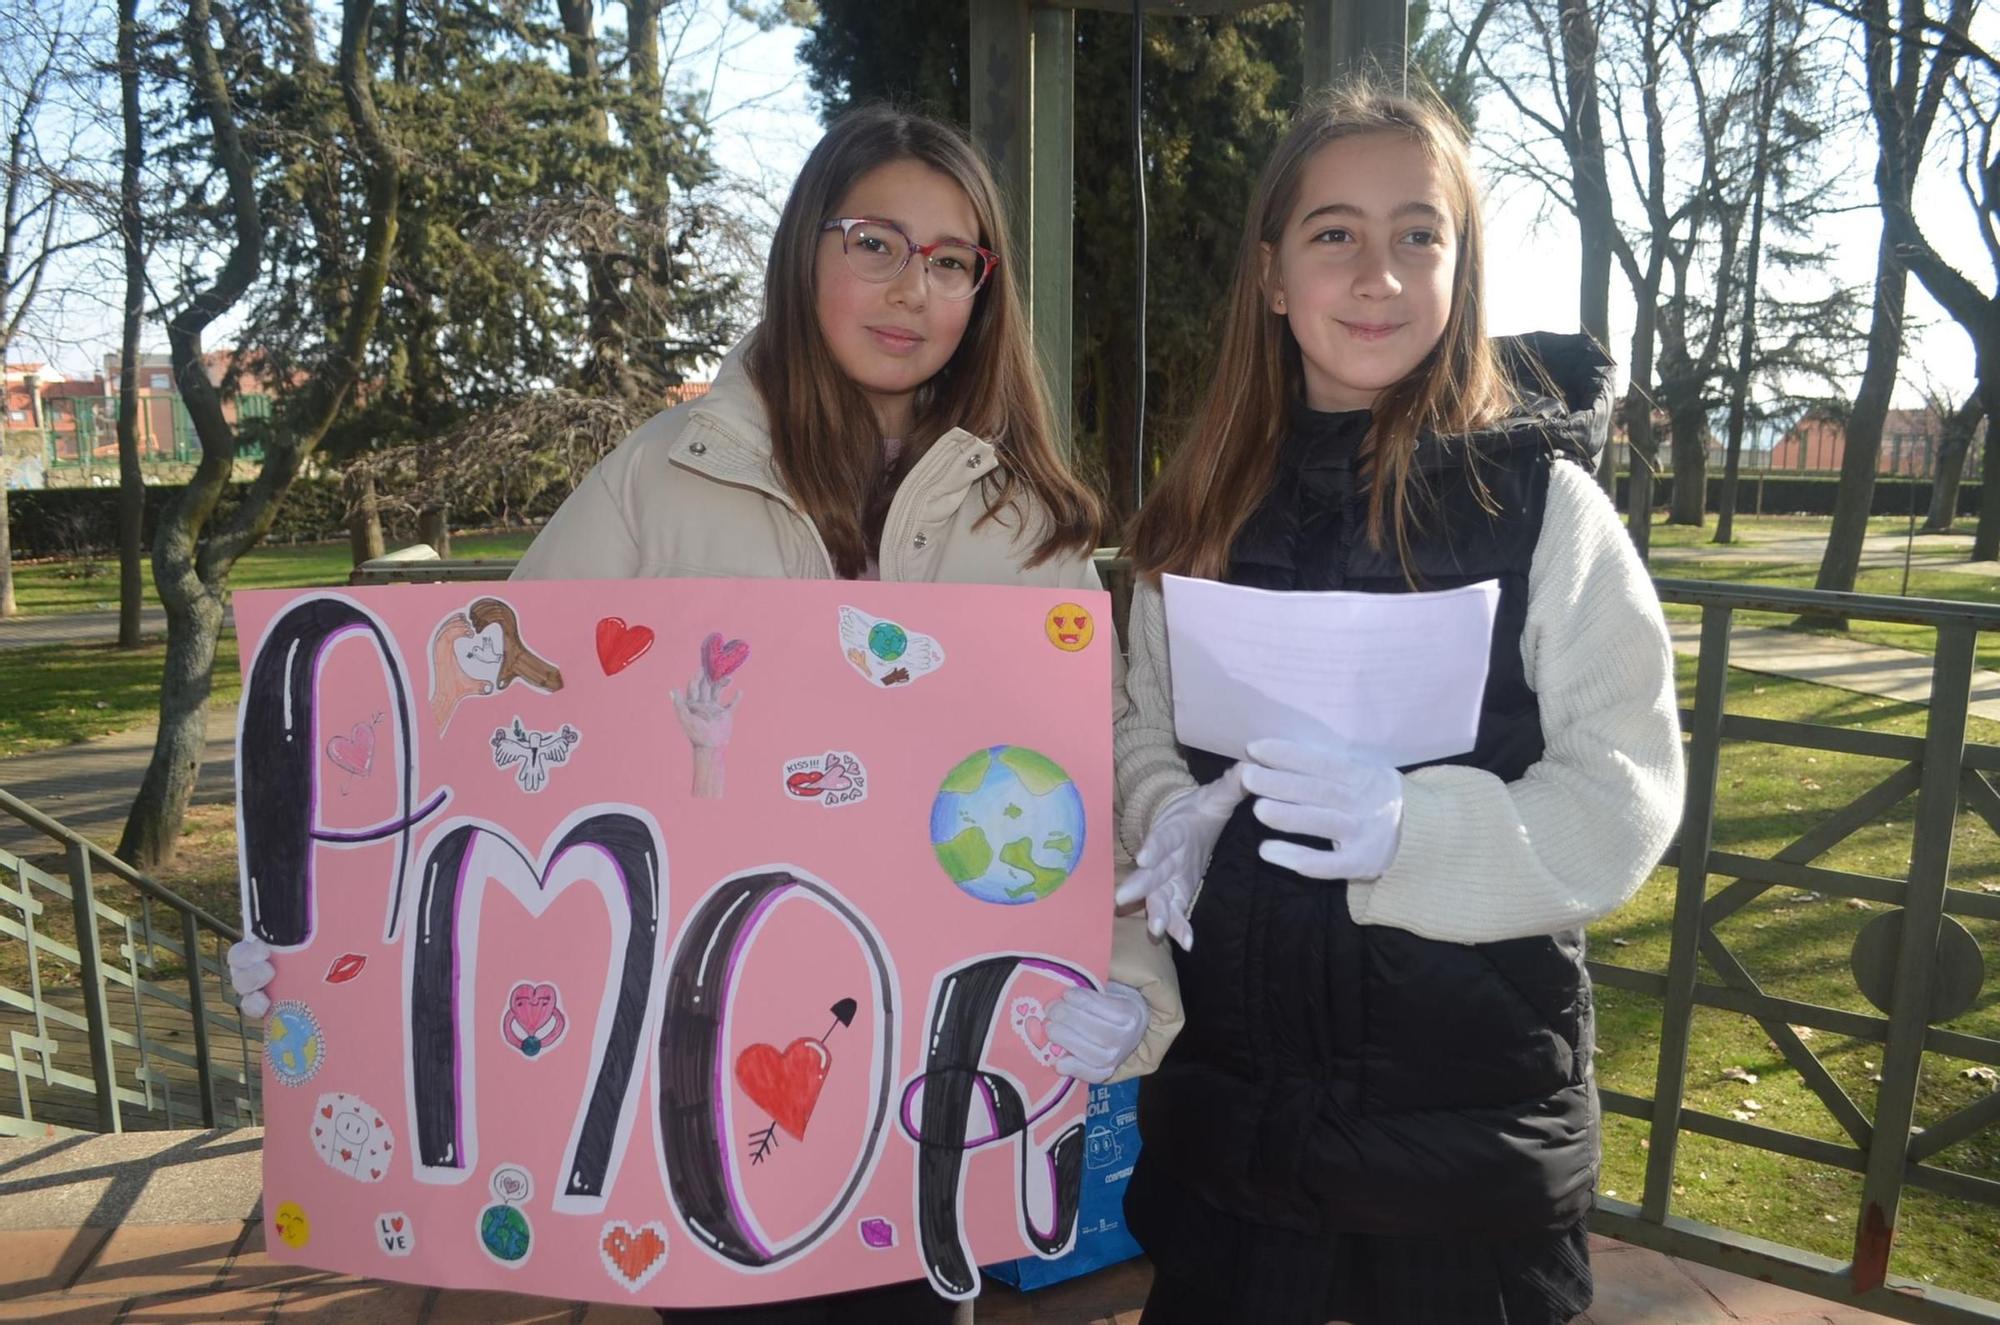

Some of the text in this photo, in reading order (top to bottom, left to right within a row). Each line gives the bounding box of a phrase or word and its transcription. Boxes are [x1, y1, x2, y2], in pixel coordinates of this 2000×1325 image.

[786, 760, 819, 773] KISS!!!
[238, 596, 1098, 1297] AMOR
[1097, 1087, 1111, 1100] EL
